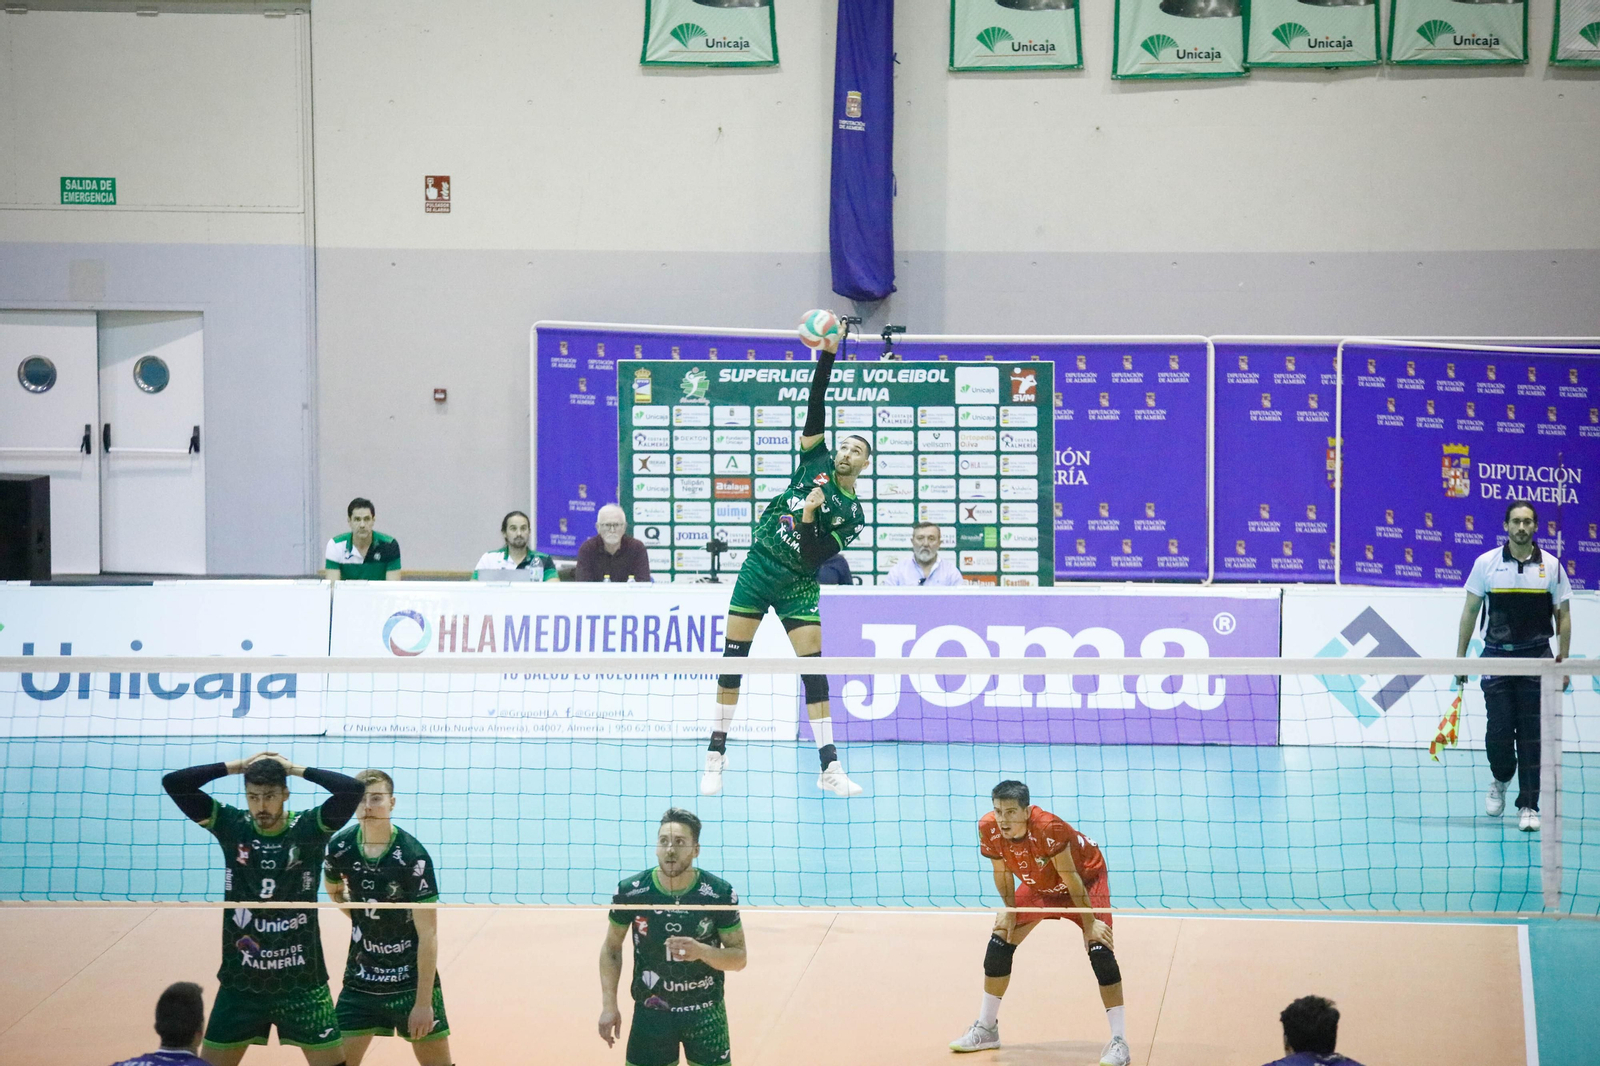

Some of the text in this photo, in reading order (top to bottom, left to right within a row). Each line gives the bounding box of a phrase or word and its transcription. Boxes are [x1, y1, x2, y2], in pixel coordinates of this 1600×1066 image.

[706, 36, 750, 50] Unicaja
[1012, 40, 1056, 53] Unicaja
[1308, 36, 1353, 50] Unicaja
[1454, 33, 1499, 48] Unicaja
[1176, 47, 1221, 60] Unicaja
[65, 179, 112, 190] SALIDA DE
[63, 192, 114, 203] EMERGENCIA
[718, 368, 949, 382] SUPERLIGA DE VOLEIBOL
[778, 387, 890, 401] MACULINA
[1012, 394, 1035, 402] SVM
[890, 438, 912, 446] Unicaja
[1478, 463, 1582, 483] DIPUTACIÓN
[680, 479, 704, 487] Tulipán
[1480, 483, 1579, 504] DE ALMERÍA
[503, 605, 724, 652] MEDITERRÁNE
[21, 639, 297, 718] Unicaja
[500, 709, 558, 718] @GrupoHLA
[575, 709, 634, 719] @GrupoHLA
[343, 724, 354, 732] C/
[356, 724, 387, 732] Nueva
[390, 724, 419, 734] Musa,
[421, 724, 427, 732] 8
[533, 724, 564, 734] 04007,
[566, 724, 604, 732] Almería
[615, 724, 632, 732] 950
[635, 724, 651, 732] 621
[654, 724, 672, 732] 063
[259, 878, 276, 899] 8
[254, 913, 308, 932] Unicaja
[260, 944, 303, 958] COSTA DE
[252, 952, 306, 970] ALMERÍA
[664, 976, 714, 992] Unicaja
